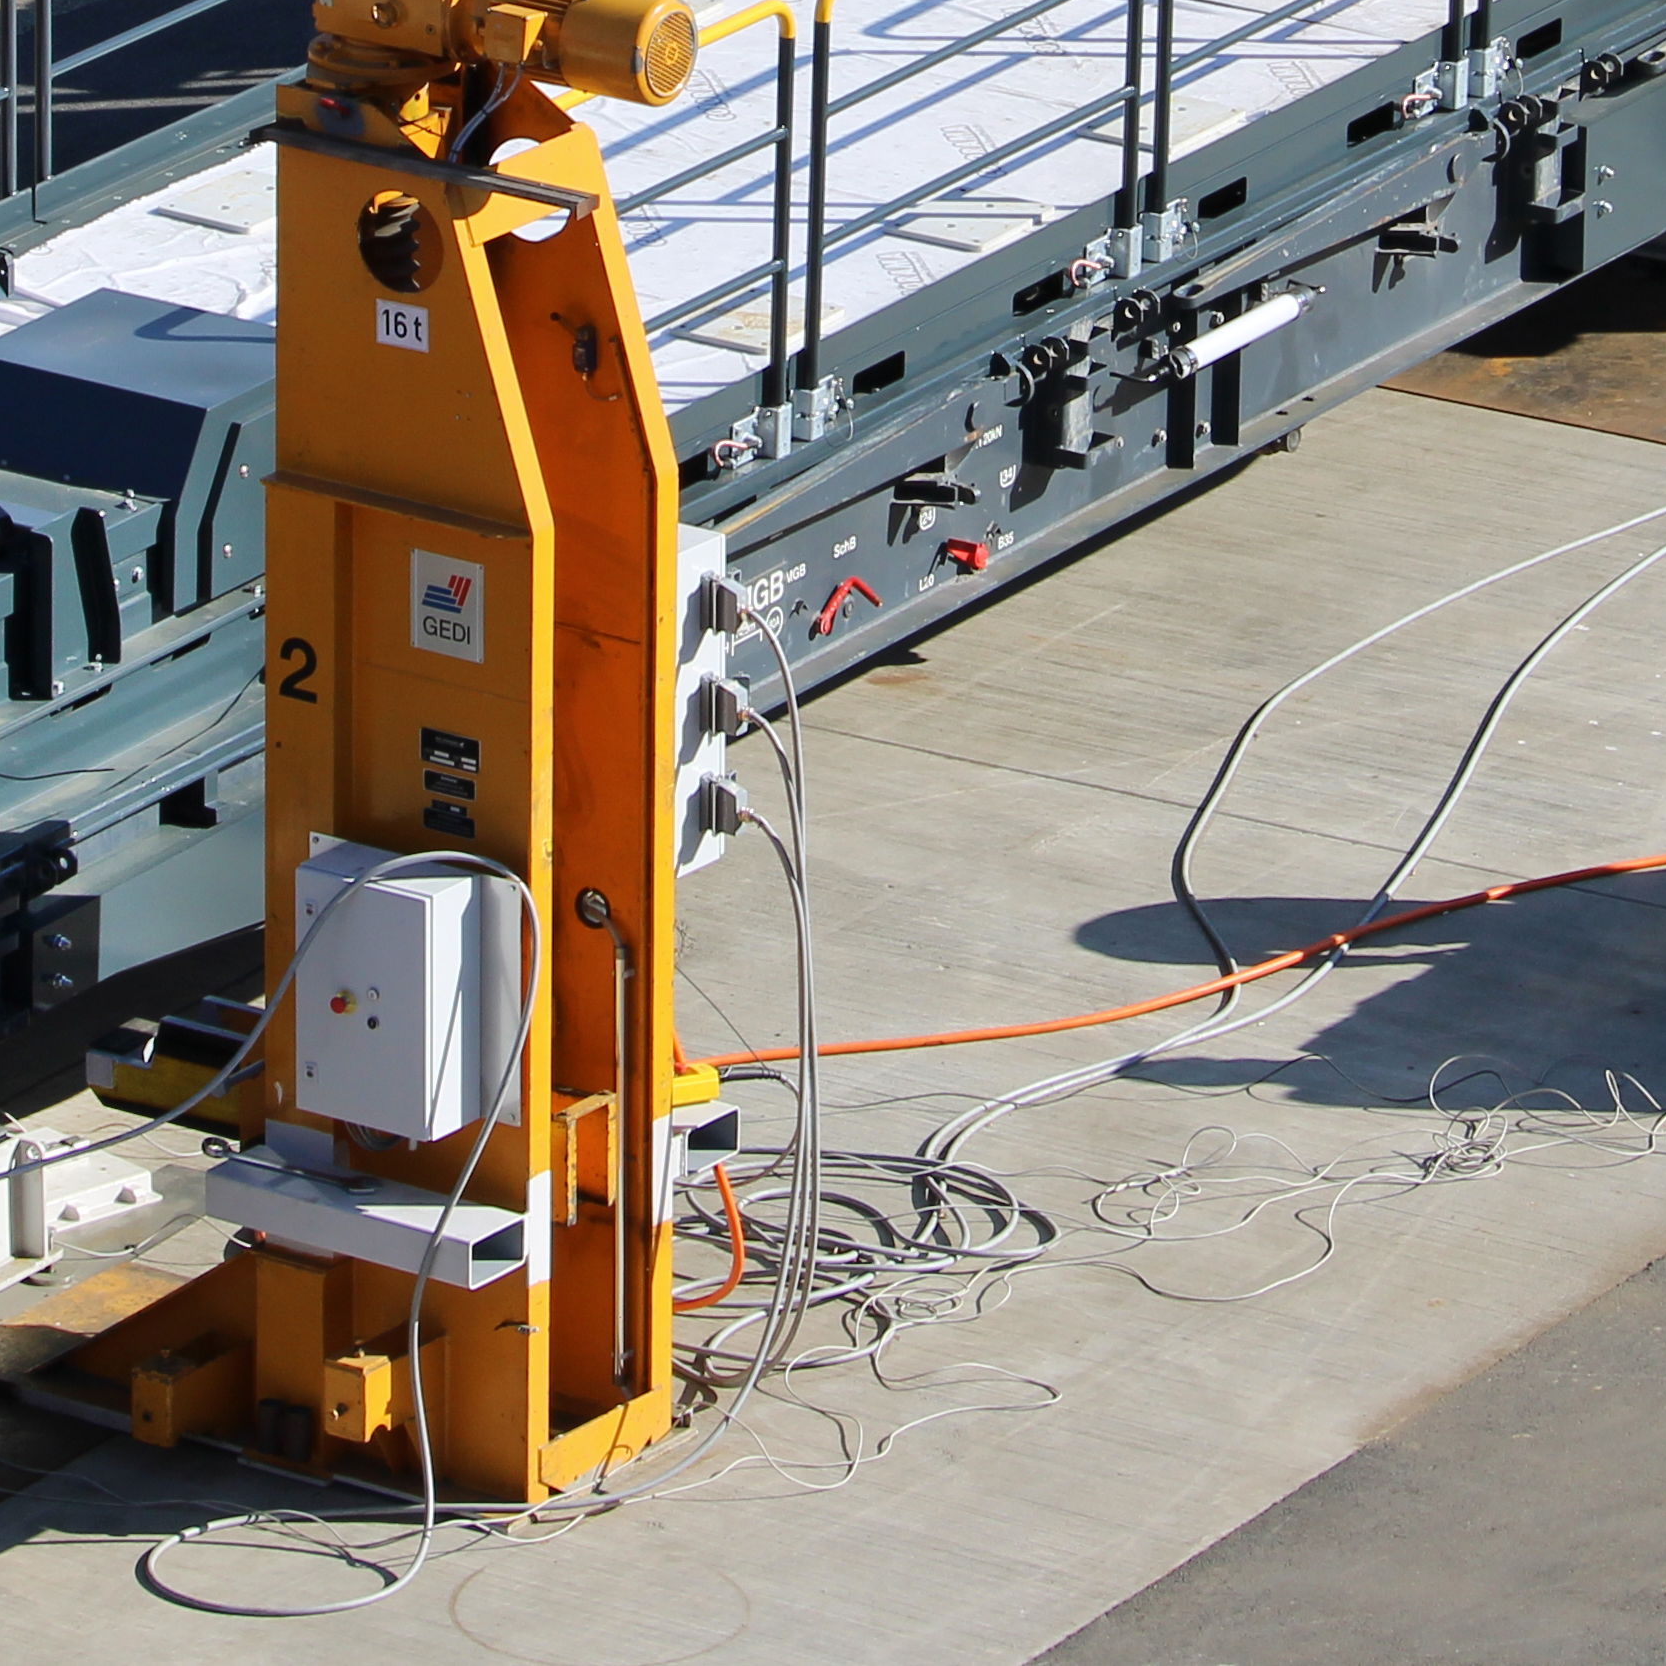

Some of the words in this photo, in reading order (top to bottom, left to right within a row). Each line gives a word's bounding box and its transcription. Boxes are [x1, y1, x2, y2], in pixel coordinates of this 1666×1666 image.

[382, 308, 408, 339] 16
[413, 316, 422, 343] t
[832, 535, 858, 559] SchB
[422, 615, 471, 645] GEDI
[278, 637, 318, 704] 2
